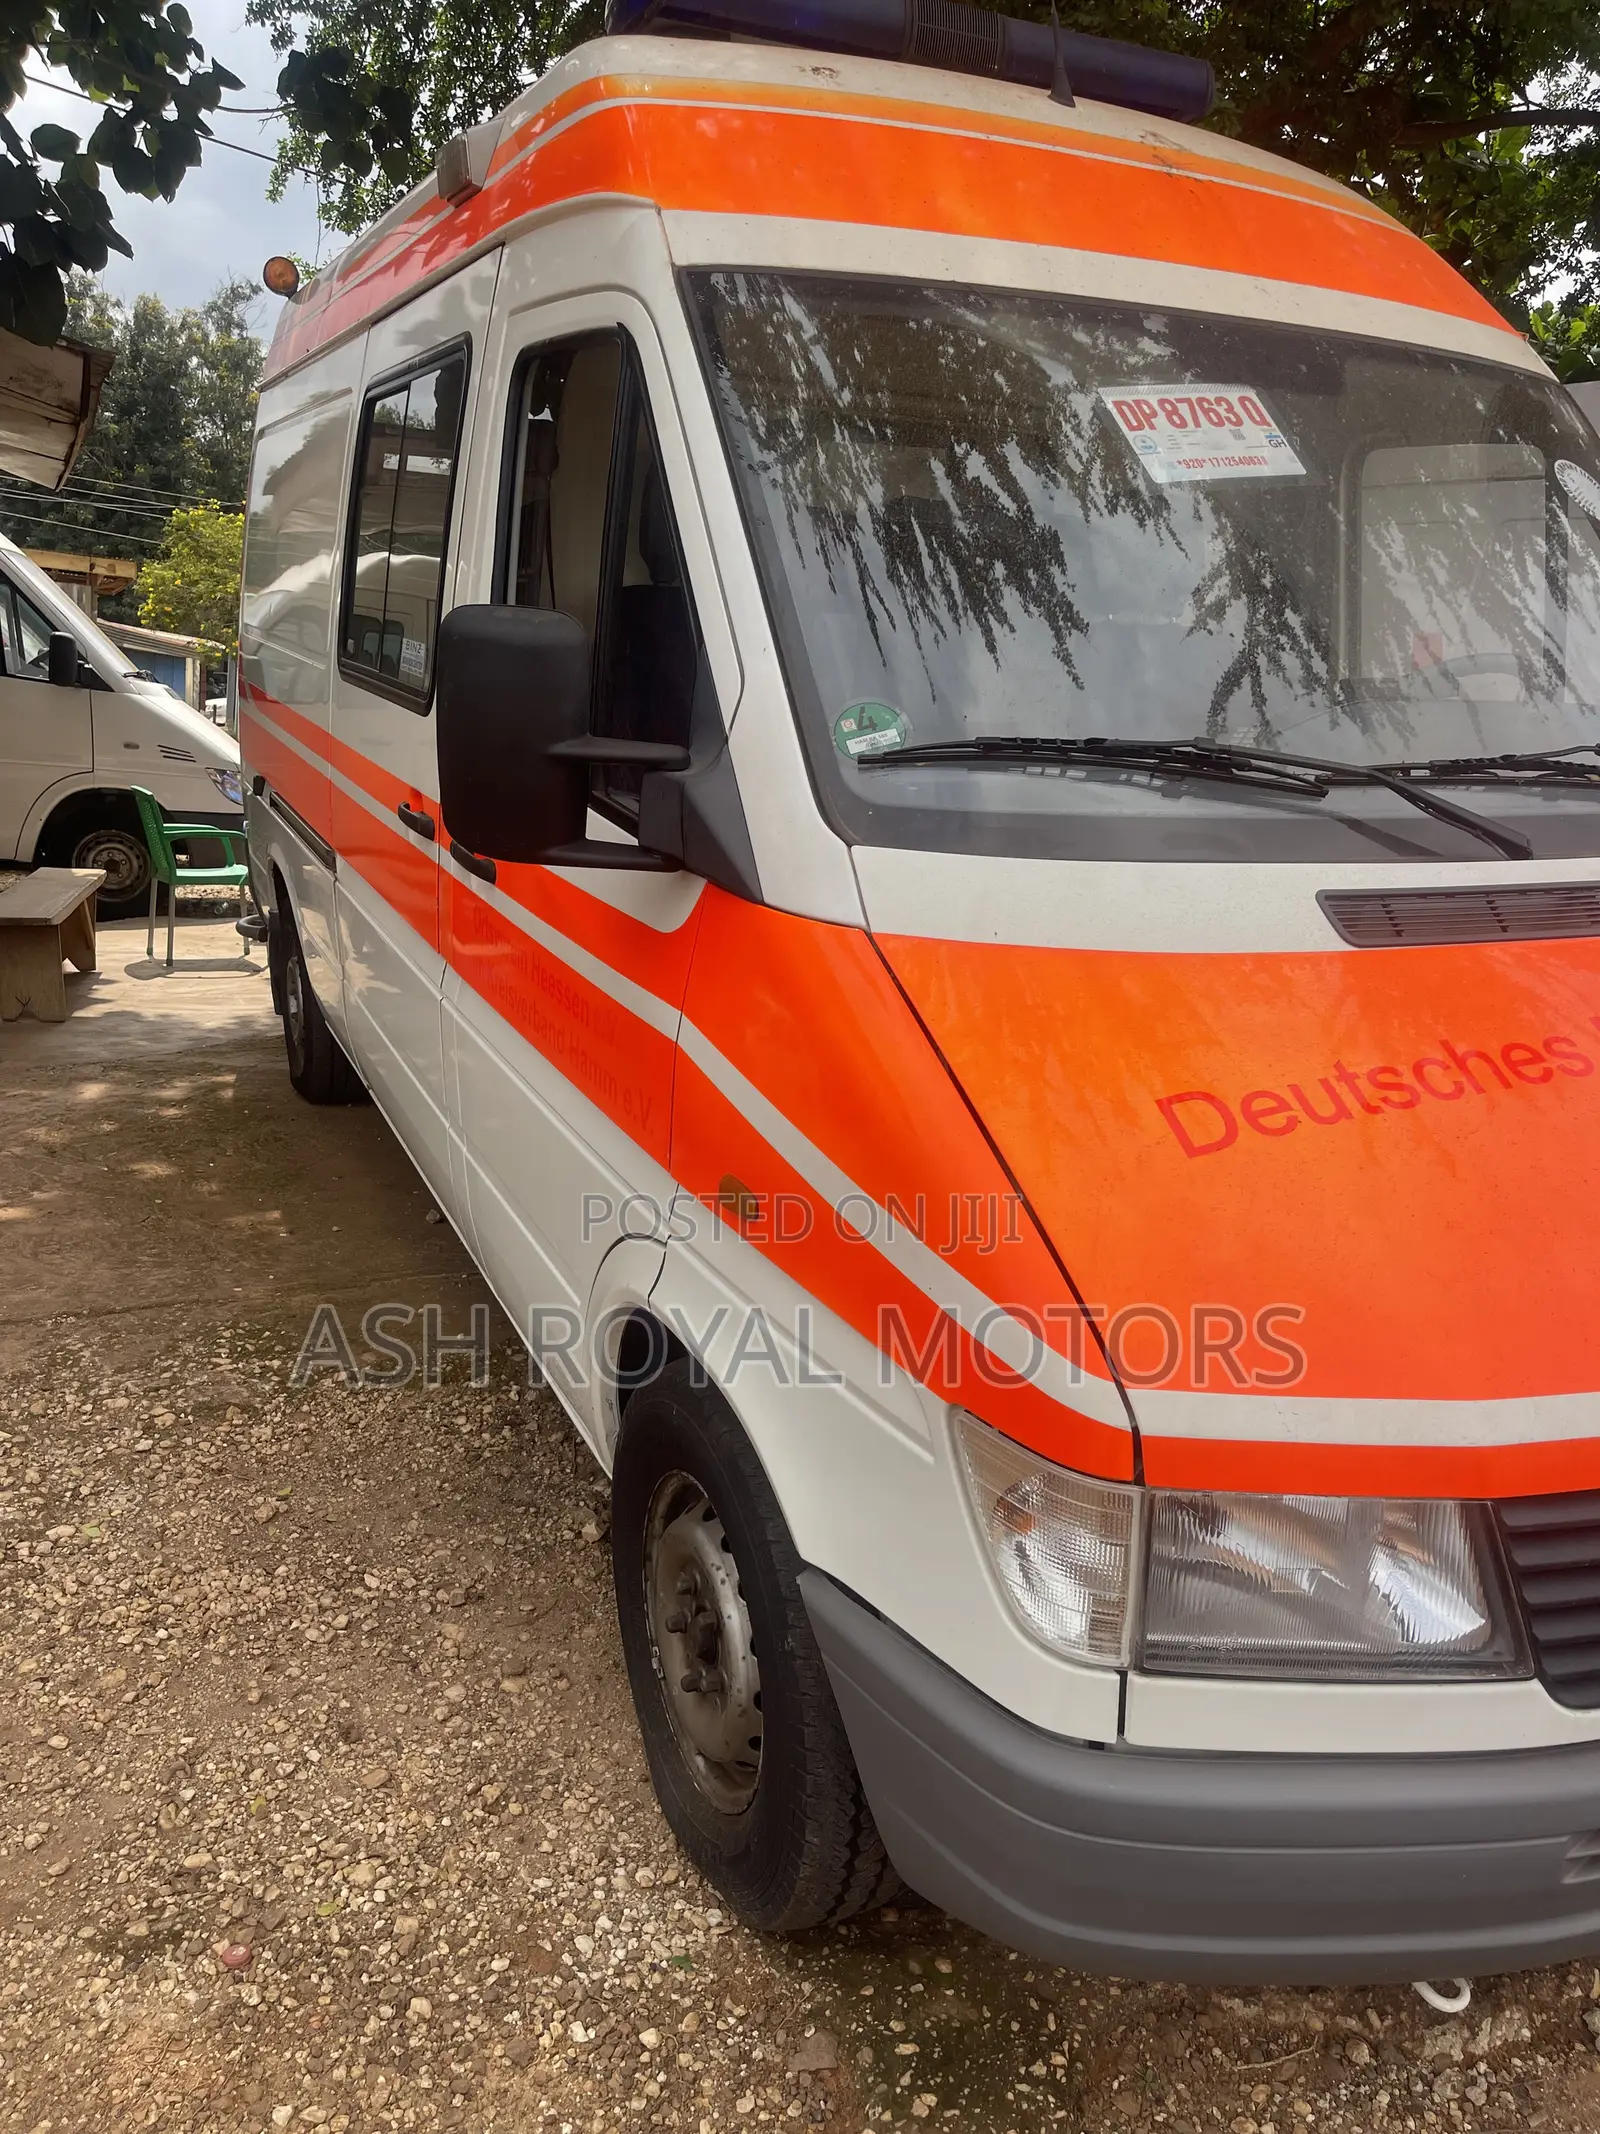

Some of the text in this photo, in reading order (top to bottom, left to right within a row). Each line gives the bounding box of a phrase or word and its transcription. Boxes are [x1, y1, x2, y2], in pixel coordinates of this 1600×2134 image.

[1111, 395, 1273, 432] DP 8763 Q
[1268, 439, 1287, 449] GH
[858, 706, 877, 731] 4
[531, 951, 590, 1027] Heessen
[487, 959, 565, 1055] Kreisverband
[569, 1031, 618, 1106] Hamm
[623, 1087, 654, 1137] e.V.
[1155, 1035, 1596, 1160] Deutsches
